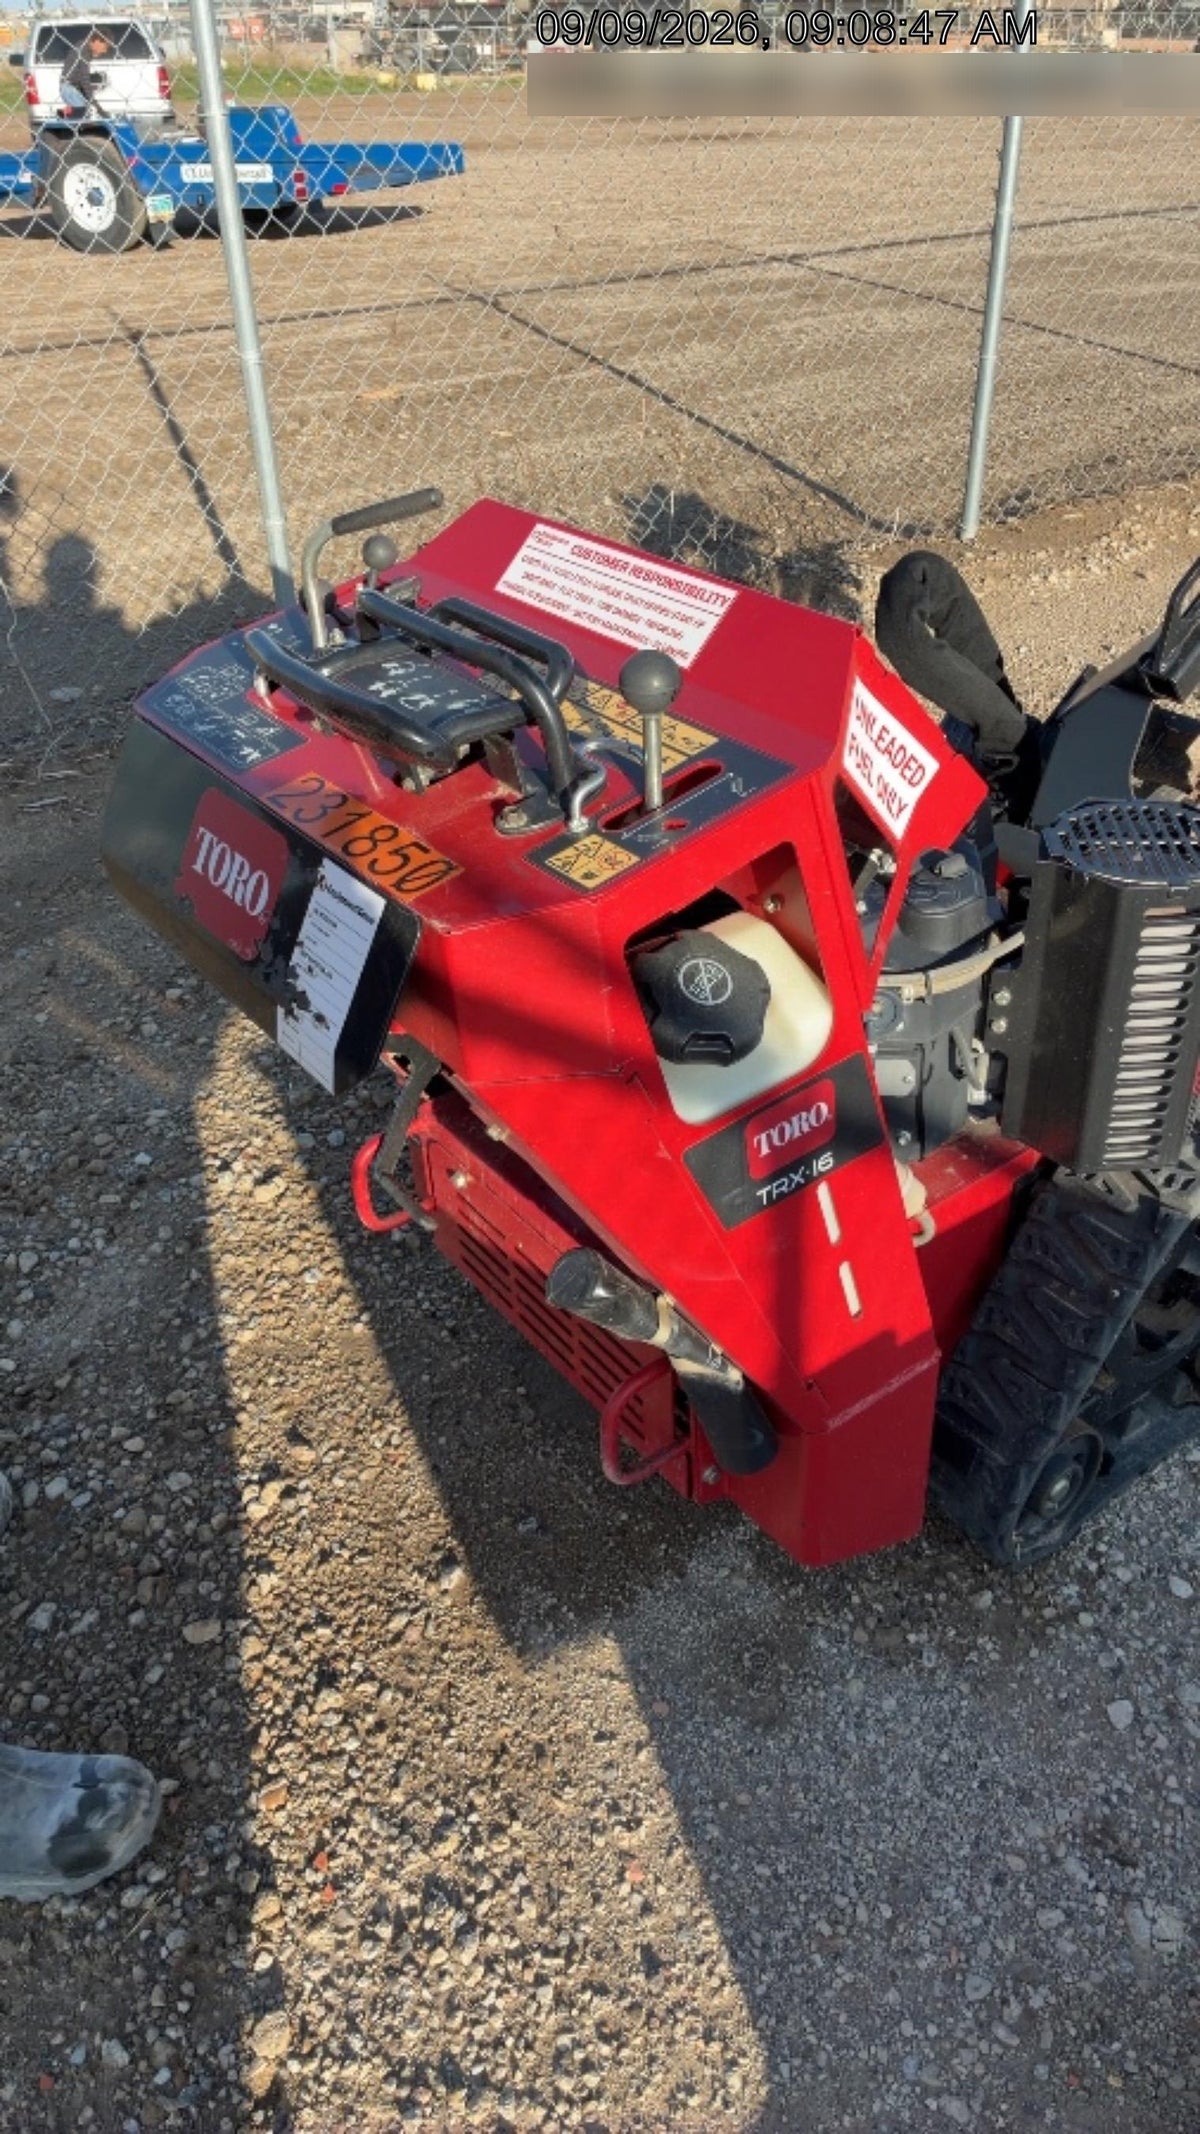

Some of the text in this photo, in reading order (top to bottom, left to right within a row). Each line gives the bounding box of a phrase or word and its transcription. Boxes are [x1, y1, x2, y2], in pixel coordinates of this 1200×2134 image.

[570, 544, 629, 572] CUSTOMER
[628, 564, 731, 607] RESPONSIBILITY
[848, 732, 909, 822] FUEL ONLY
[855, 695, 926, 788] UNLEADED
[191, 826, 269, 916] TORO
[265, 776, 459, 893] 231850
[753, 1102, 829, 1157] TORO
